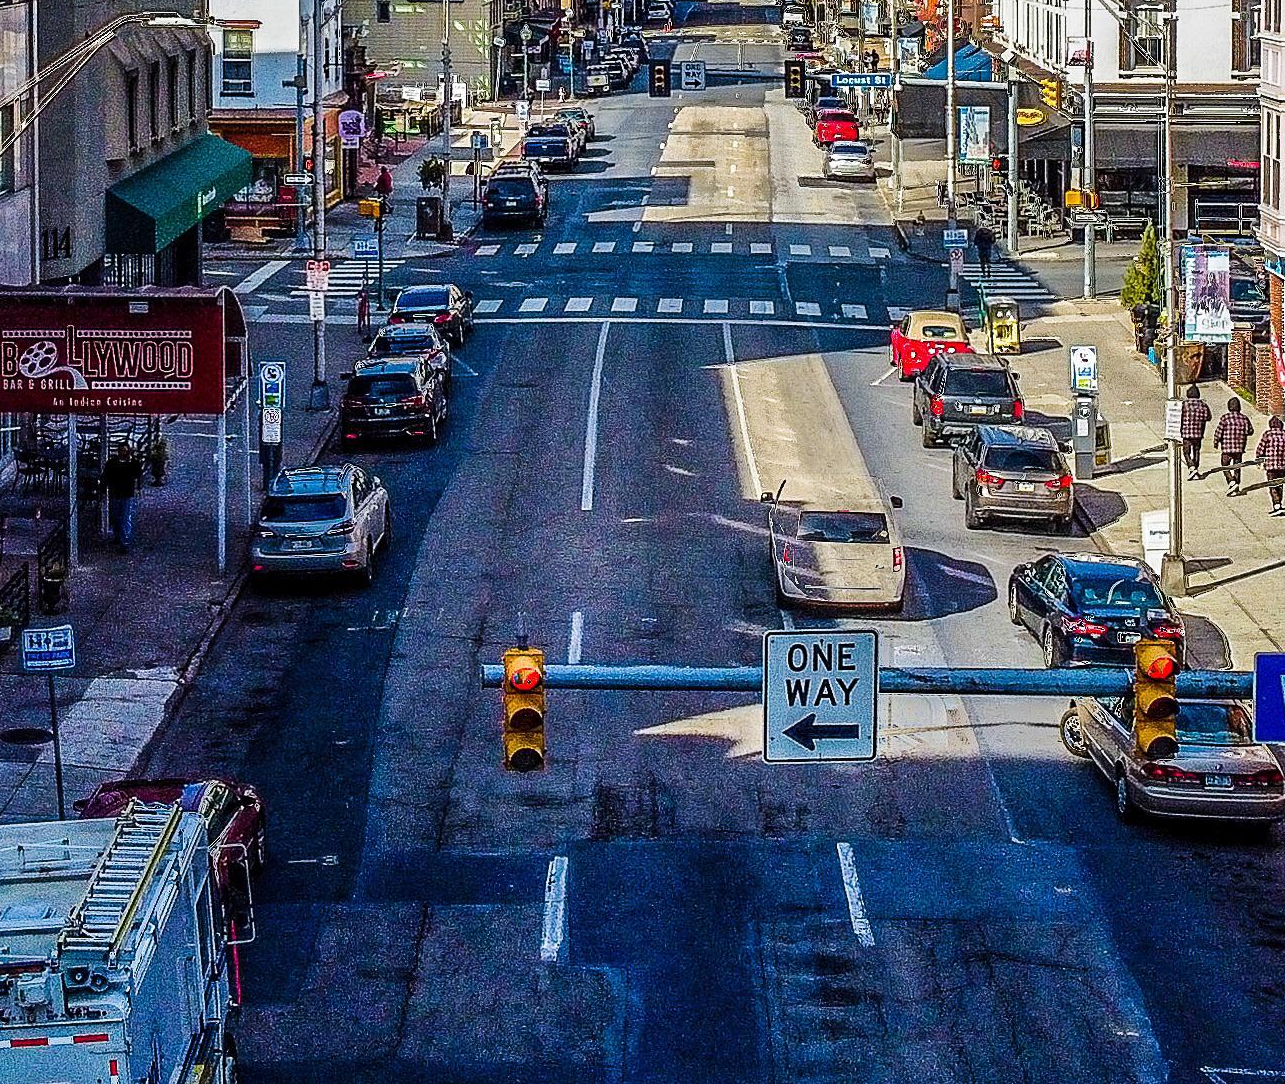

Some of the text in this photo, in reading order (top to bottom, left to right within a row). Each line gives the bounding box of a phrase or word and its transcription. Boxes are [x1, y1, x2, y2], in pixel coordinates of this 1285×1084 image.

[836, 76, 886, 84] Locust St
[3, 379, 23, 390] BAR
[41, 379, 72, 390] GRILL
[53, 397, 65, 407] An
[787, 643, 856, 672] ONE
[786, 679, 860, 706] WAY
